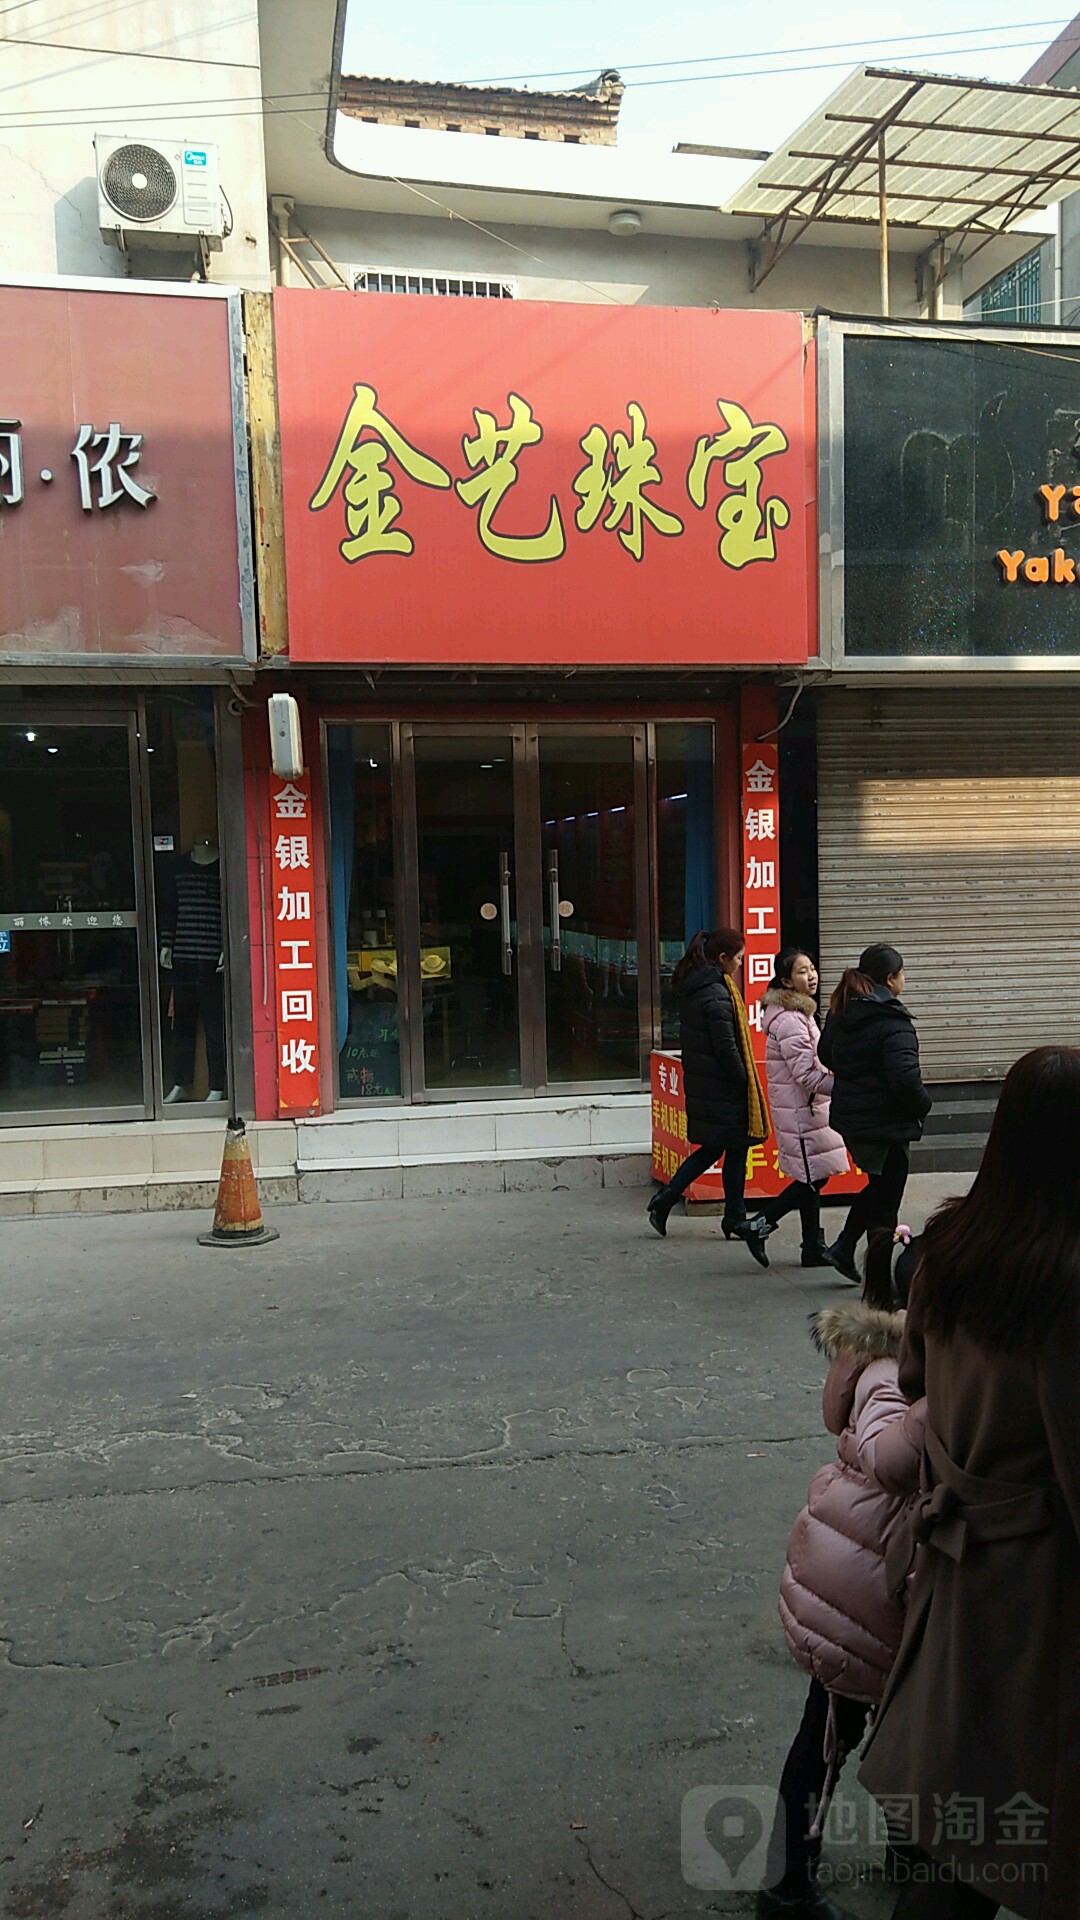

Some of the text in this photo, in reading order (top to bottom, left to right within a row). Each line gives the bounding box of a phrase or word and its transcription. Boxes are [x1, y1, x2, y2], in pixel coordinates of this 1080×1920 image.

[310, 383, 790, 571] 金艺珠宝
[997, 547, 1080, 584] Yak
[273, 783, 316, 1075] 金银加工回收
[658, 1062, 679, 1096] 专业
